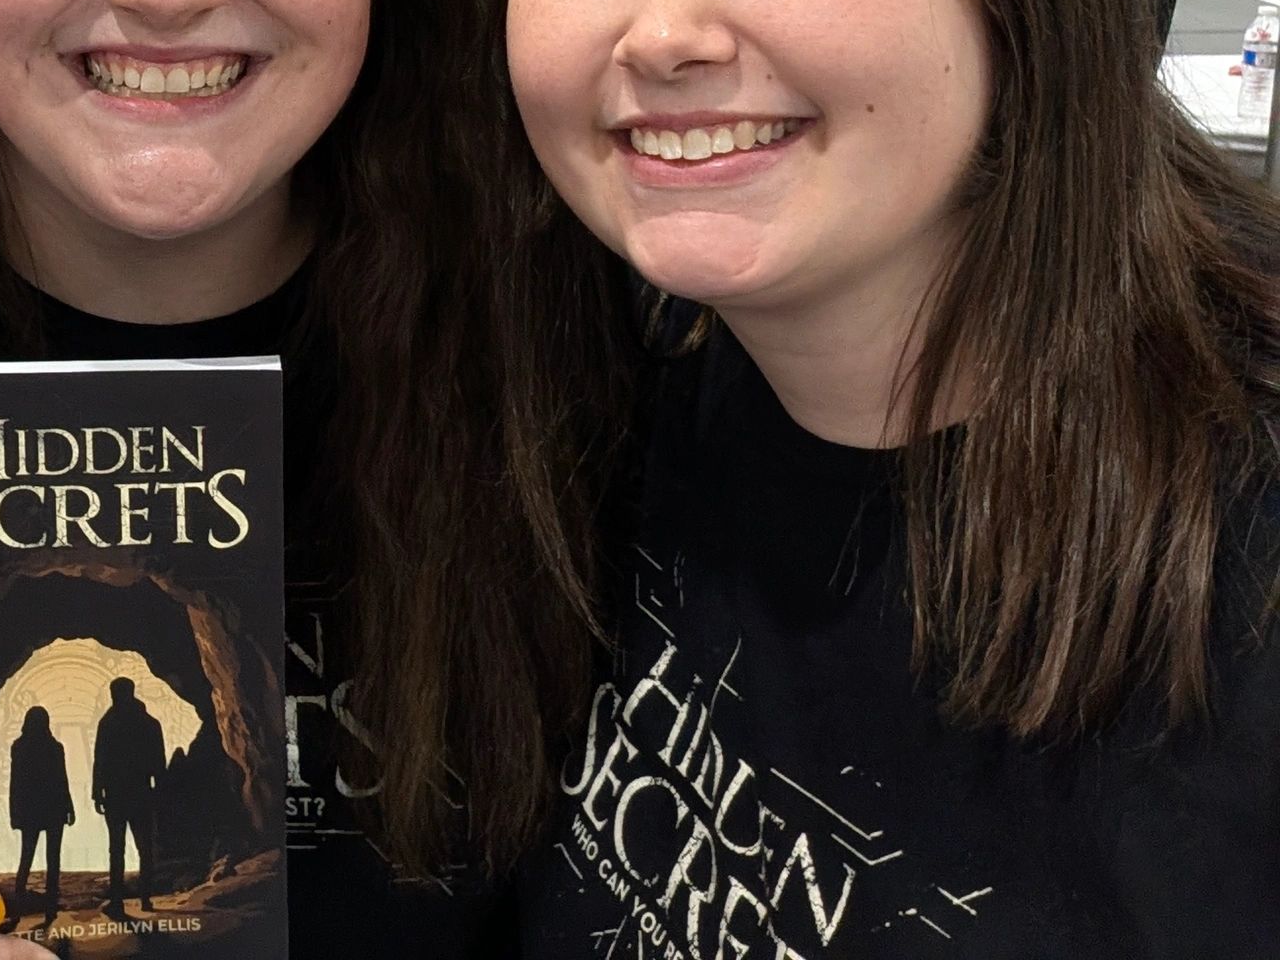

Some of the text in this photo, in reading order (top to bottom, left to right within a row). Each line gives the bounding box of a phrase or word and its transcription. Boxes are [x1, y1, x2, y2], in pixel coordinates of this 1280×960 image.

[571, 813, 599, 861] WHO
[599, 859, 631, 902] CAN
[631, 895, 667, 946] YOU
[48, 924, 85, 939] AND
[87, 919, 153, 936] JERILYN
[158, 918, 201, 932] ELLIS
